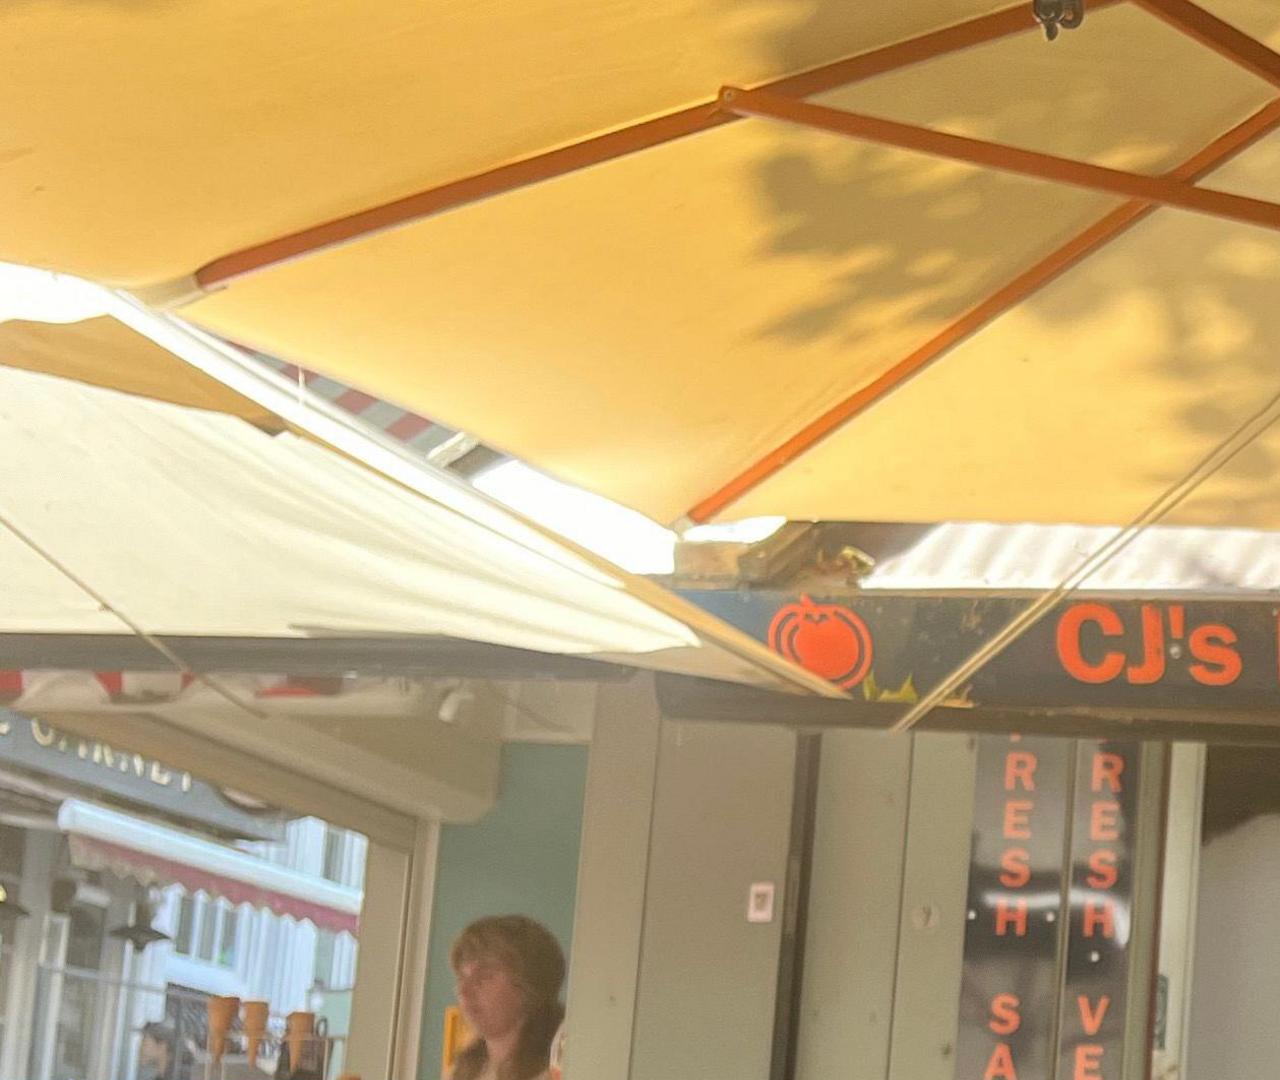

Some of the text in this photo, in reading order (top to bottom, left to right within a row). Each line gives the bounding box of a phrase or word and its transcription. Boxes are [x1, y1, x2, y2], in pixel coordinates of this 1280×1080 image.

[1055, 603, 1242, 686] CJ's
[992, 735, 1038, 937] RESH
[1083, 737, 1126, 938] RESH
